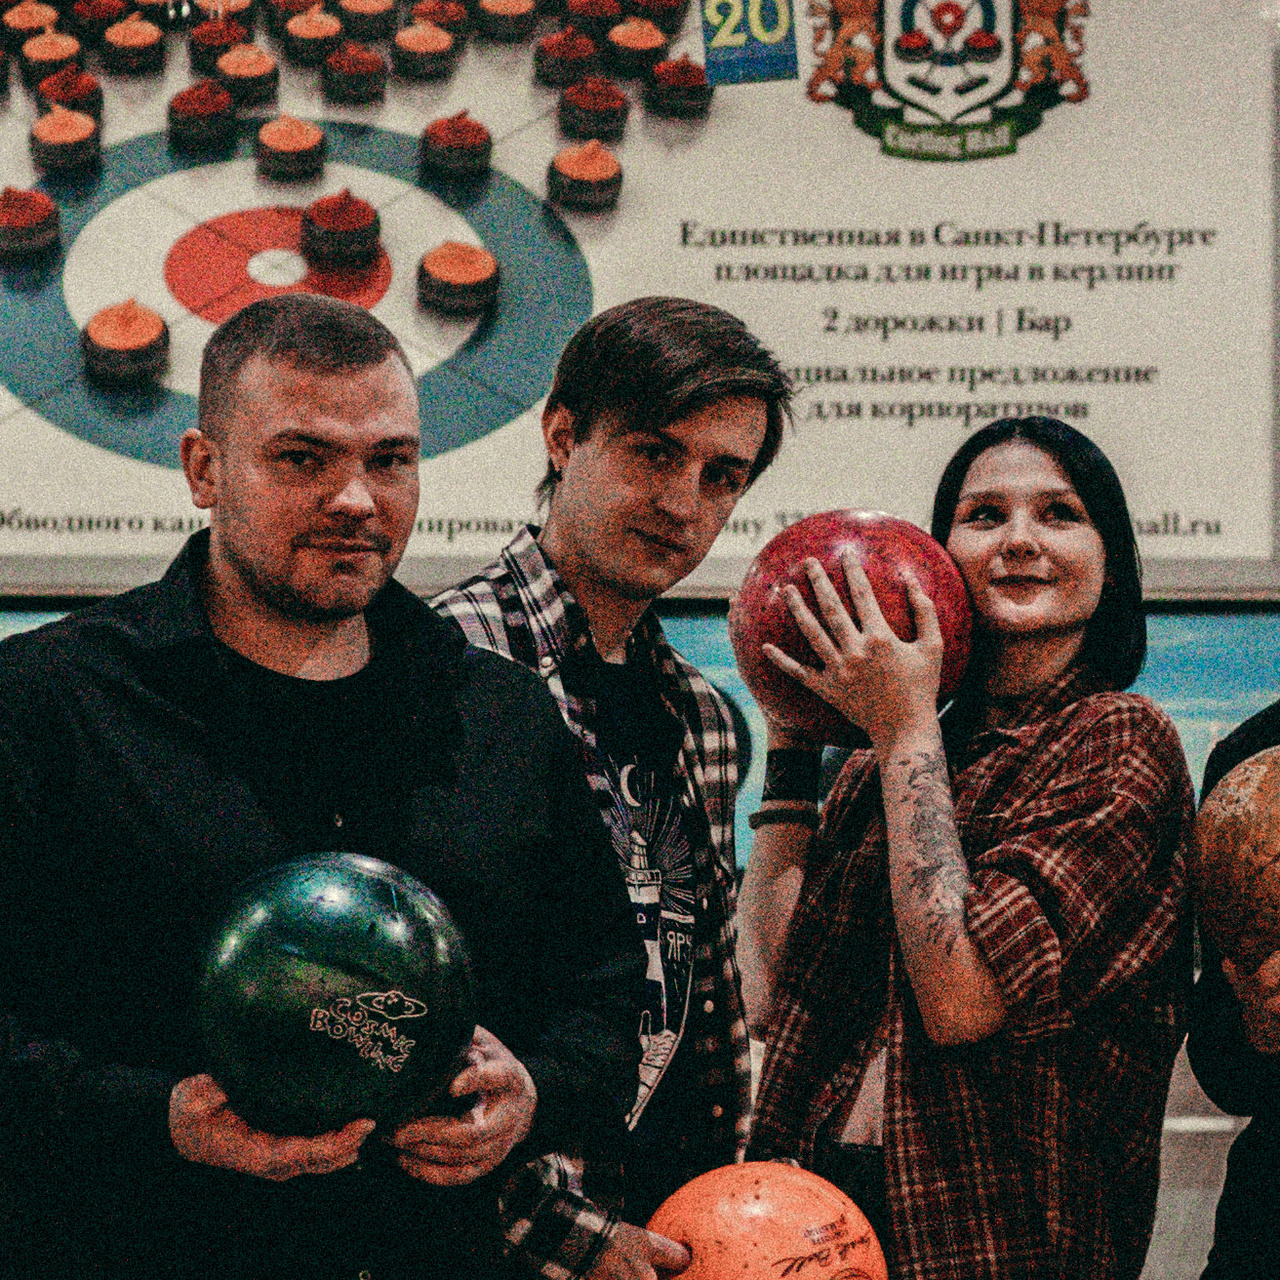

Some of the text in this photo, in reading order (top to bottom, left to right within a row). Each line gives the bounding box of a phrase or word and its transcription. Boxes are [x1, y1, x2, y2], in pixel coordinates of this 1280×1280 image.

[679, 219, 1219, 257] Единственная в Санкт-Петербурге
[714, 262, 1182, 291] площадка для игры в керлинг
[821, 306, 841, 334] 2
[843, 309, 987, 342] дорожки
[1015, 306, 1074, 342] Бар
[948, 363, 1161, 392] предложение
[806, 400, 864, 422] для
